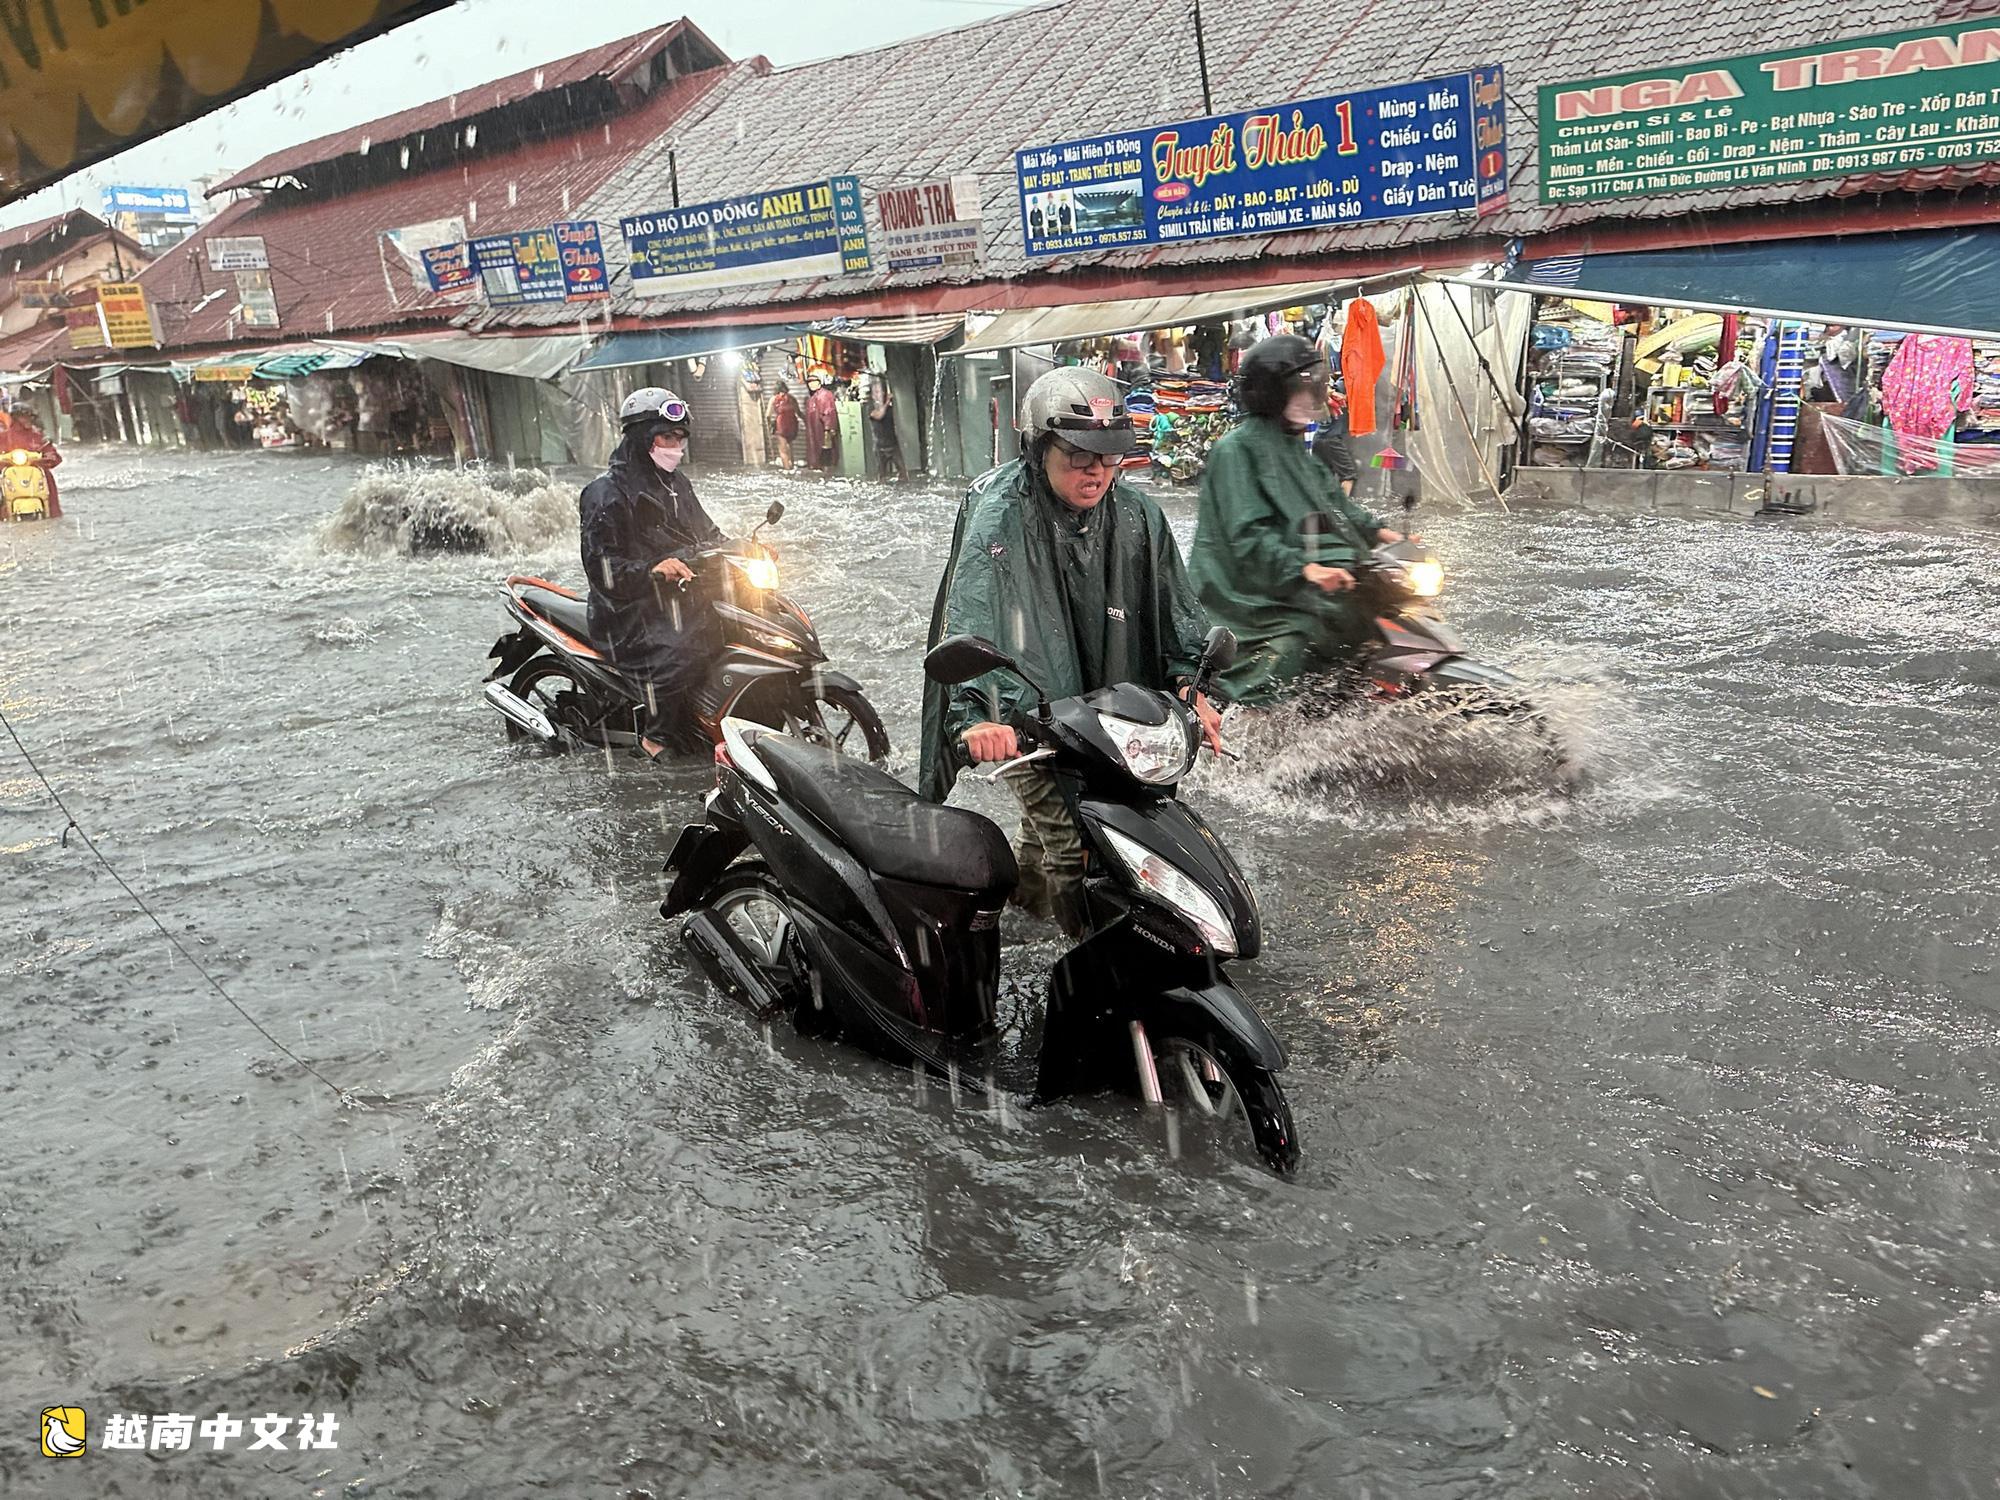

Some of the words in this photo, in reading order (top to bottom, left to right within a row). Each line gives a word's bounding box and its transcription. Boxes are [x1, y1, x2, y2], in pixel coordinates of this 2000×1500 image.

[1555, 70, 1745, 121] NGA
[1760, 28, 2000, 91] TRAN
[1379, 99, 1417, 119] Mùng
[1428, 88, 1459, 112] Mền
[1380, 124, 1420, 149] Chiếu
[1432, 118, 1457, 141] Gối
[1550, 142, 1581, 157] Thảm
[1585, 138, 1602, 153] Lót
[1637, 131, 1673, 147] Simili
[1686, 126, 1710, 141] Bao
[1714, 122, 1728, 138] Bì
[1741, 120, 1758, 134] Pe
[1771, 114, 1794, 132] Bạt
[1798, 111, 1835, 128] Nhựa
[1849, 105, 1877, 121] Sáo
[1882, 102, 1905, 117] Tre
[1920, 93, 1950, 112] Xốp
[1955, 91, 1986, 109] Dán
[1558, 119, 1639, 138] Chuyên
[1678, 112, 1696, 122] &
[1022, 153, 1038, 169] Mái
[1040, 148, 1057, 168] Xếp
[1064, 146, 1080, 162] Mái
[1082, 144, 1103, 160] Hiên
[1104, 141, 1115, 156] Di
[1116, 138, 1141, 158] Động
[1152, 122, 1238, 188] Tuyết
[1242, 109, 1328, 169] Thảo
[1335, 100, 1358, 156] 1
[1551, 162, 1584, 179] Mùng
[1637, 150, 1674, 168] Chiếu
[1687, 145, 1709, 162] Gối
[1723, 143, 1756, 160] Drap
[1770, 137, 1803, 155] Nệm
[1819, 130, 1860, 147] Thảm
[1876, 126, 1905, 142] Cây
[1910, 123, 1939, 138] Lau
[1956, 115, 1999, 132] Khăn
[1024, 175, 1038, 189] MAY
[1042, 170, 1051, 187] ÉP
[1052, 171, 1065, 188] BẠT
[1069, 166, 1092, 182] TRANG
[1092, 158, 1113, 179] THIẾT
[1114, 161, 1122, 179] BỊ
[1381, 160, 1414, 178] Drap
[1425, 153, 1459, 175] Nệm
[1487, 153, 1497, 177] 1
[1568, 184, 1588, 200] Sạp
[1591, 181, 1609, 194] 117
[1613, 179, 1634, 193] Chợ
[1636, 178, 1645, 189] A
[1647, 174, 1667, 188] Thủ
[1670, 172, 1692, 186] Đức
[1734, 166, 1749, 179] Lê
[1752, 163, 1774, 178] Văn
[1777, 160, 1806, 175] Ninh
[1837, 154, 1869, 169] 0913
[1872, 151, 1897, 166] 987
[1899, 148, 1925, 163] 675
[1937, 143, 1972, 159] 0703
[1977, 140, 2000, 155] 752
[1157, 204, 1183, 219] Chuyên
[1193, 200, 1200, 213] &
[1214, 193, 1236, 211] DÂY
[1244, 191, 1267, 207] BAO
[1275, 186, 1297, 206] BẠT
[1306, 178, 1334, 199] LƯỚI
[1342, 174, 1360, 195] DÙ
[1383, 183, 1415, 207] Giấy
[1417, 182, 1446, 202] Dán
[625, 217, 654, 237] BẢO
[656, 214, 679, 234] HỘ
[681, 210, 710, 229] LAO
[712, 201, 759, 225] ĐỘNG
[761, 191, 804, 220] ANH
[841, 210, 857, 221] LAO
[1158, 221, 1188, 239] SIMILI
[1189, 214, 1212, 236] TRẢI
[1241, 210, 1256, 230] ÁO
[1257, 206, 1287, 227] TRÙM
[1288, 207, 1304, 223] XE
[1311, 200, 1337, 221] MÀN
[1338, 197, 1362, 218] SÁO
[843, 237, 866, 252] ANH
[577, 267, 592, 281] 2
[845, 256, 869, 270] LINH
[1133, 923, 1176, 954] HONDA
